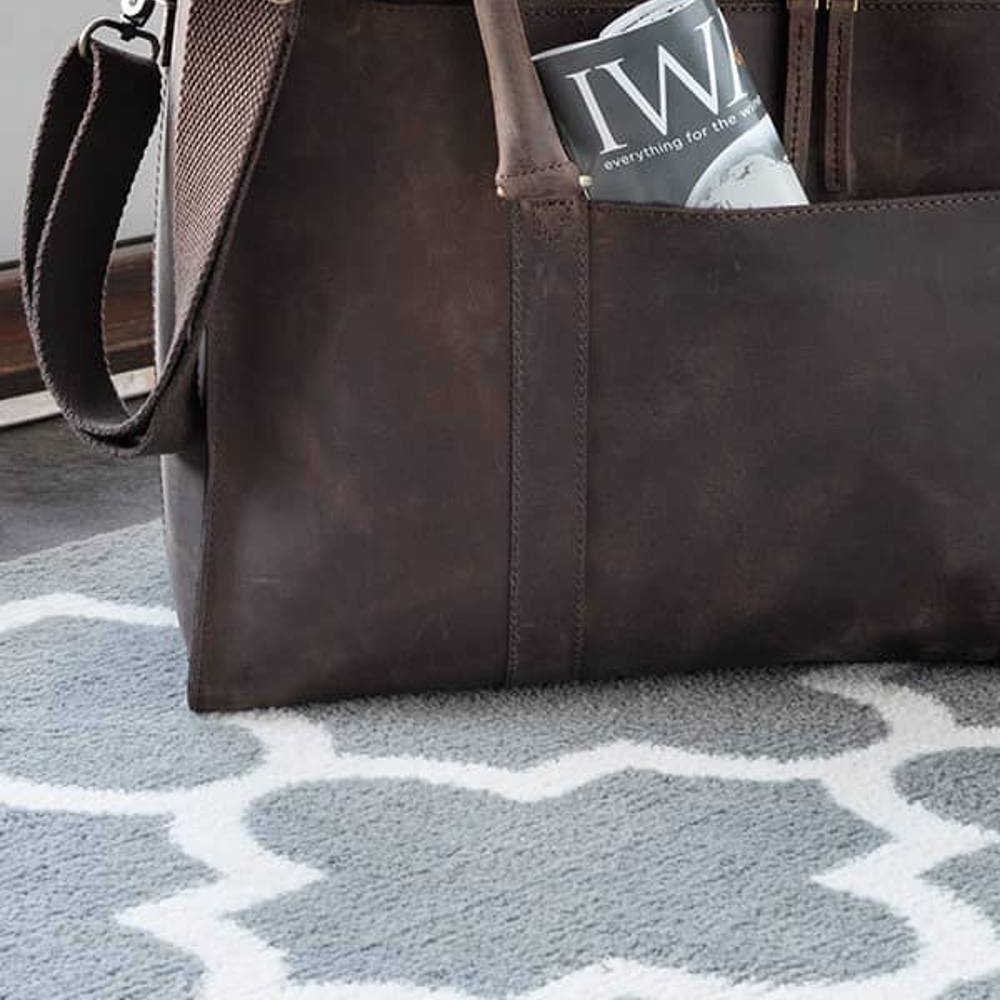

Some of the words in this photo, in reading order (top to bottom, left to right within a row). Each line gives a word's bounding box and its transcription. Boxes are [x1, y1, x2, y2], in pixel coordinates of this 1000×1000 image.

[603, 137, 684, 171] everything
[685, 128, 708, 143] for
[711, 114, 737, 132] the
